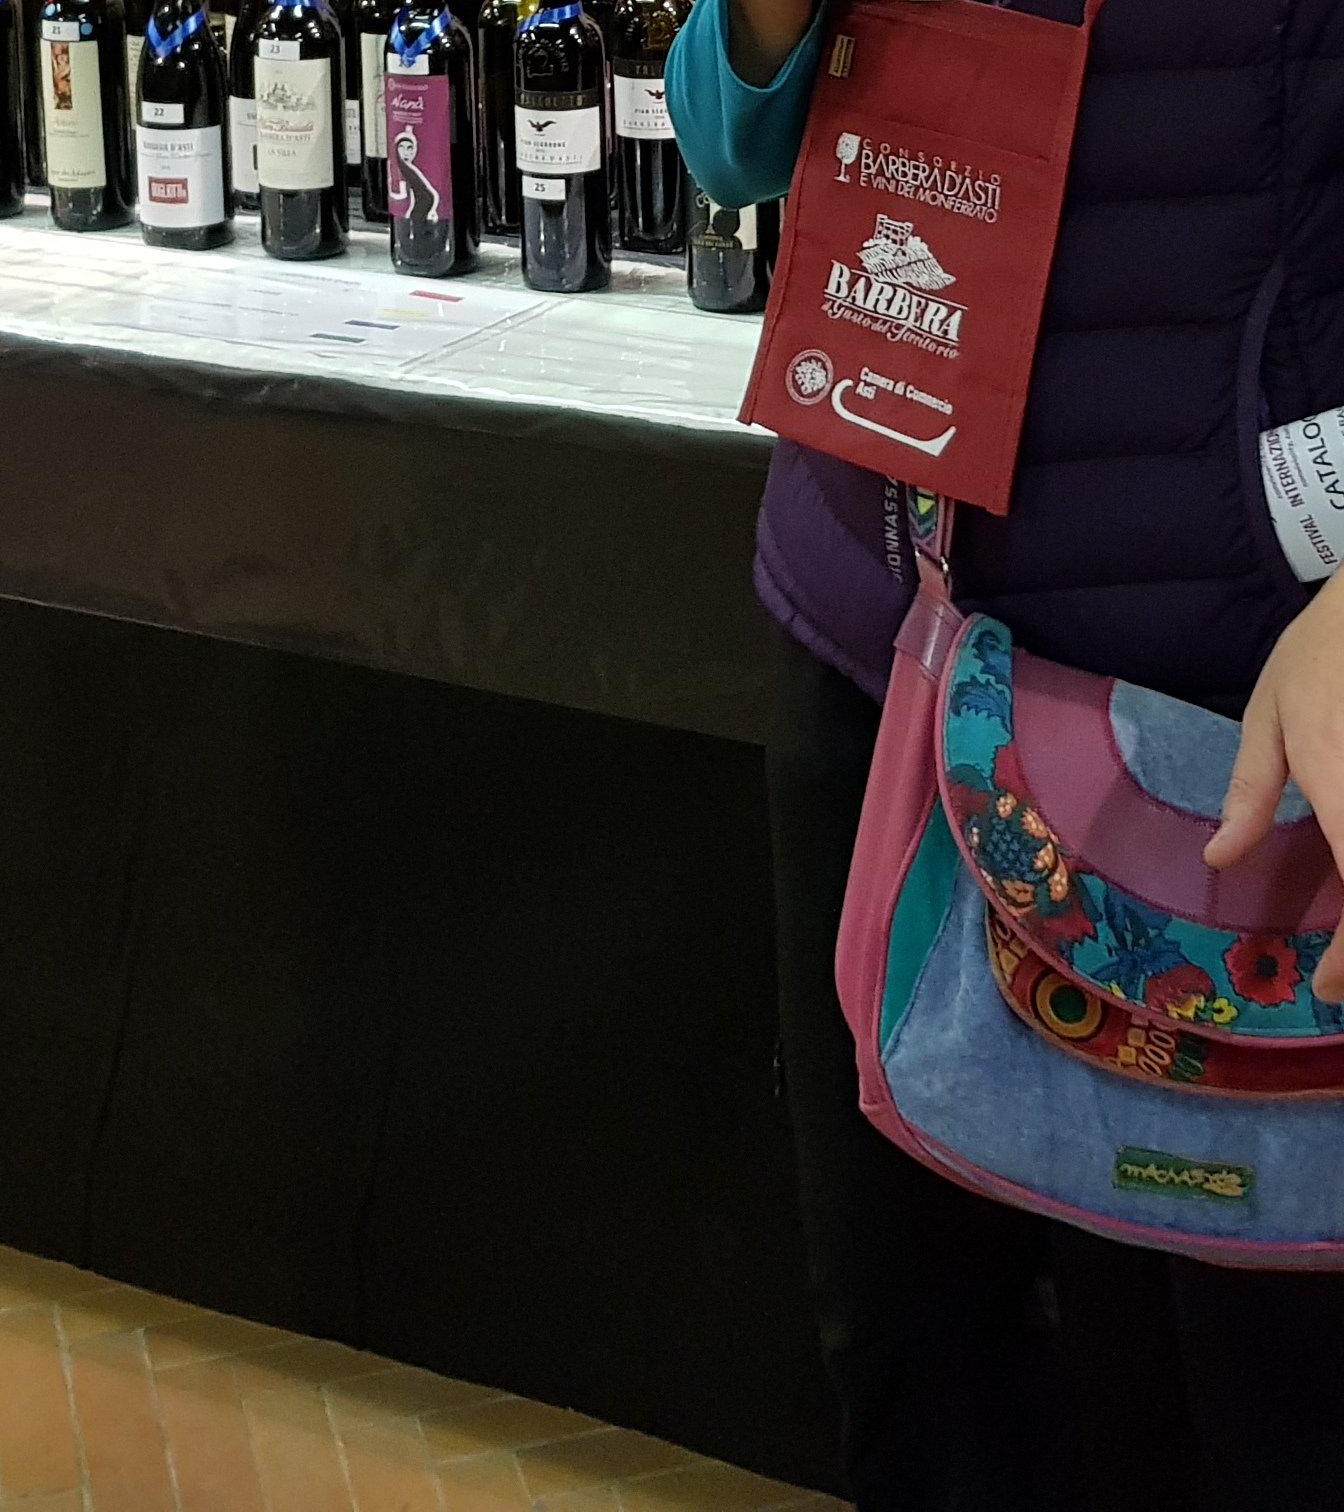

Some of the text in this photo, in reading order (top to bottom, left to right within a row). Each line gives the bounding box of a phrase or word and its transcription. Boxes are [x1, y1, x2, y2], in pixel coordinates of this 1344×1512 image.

[270, 44, 281, 54] 23
[154, 107, 165, 116] 22
[861, 149, 943, 193] BARBERA
[863, 138, 1001, 185] CONSORZIO
[534, 182, 546, 193] 25
[860, 172, 997, 224] E VINI DEL MONFERRATO
[824, 259, 963, 342] BARBERA
[1266, 428, 1306, 508] INTERNAZIO
[1299, 513, 1339, 565] FESTIVAL
